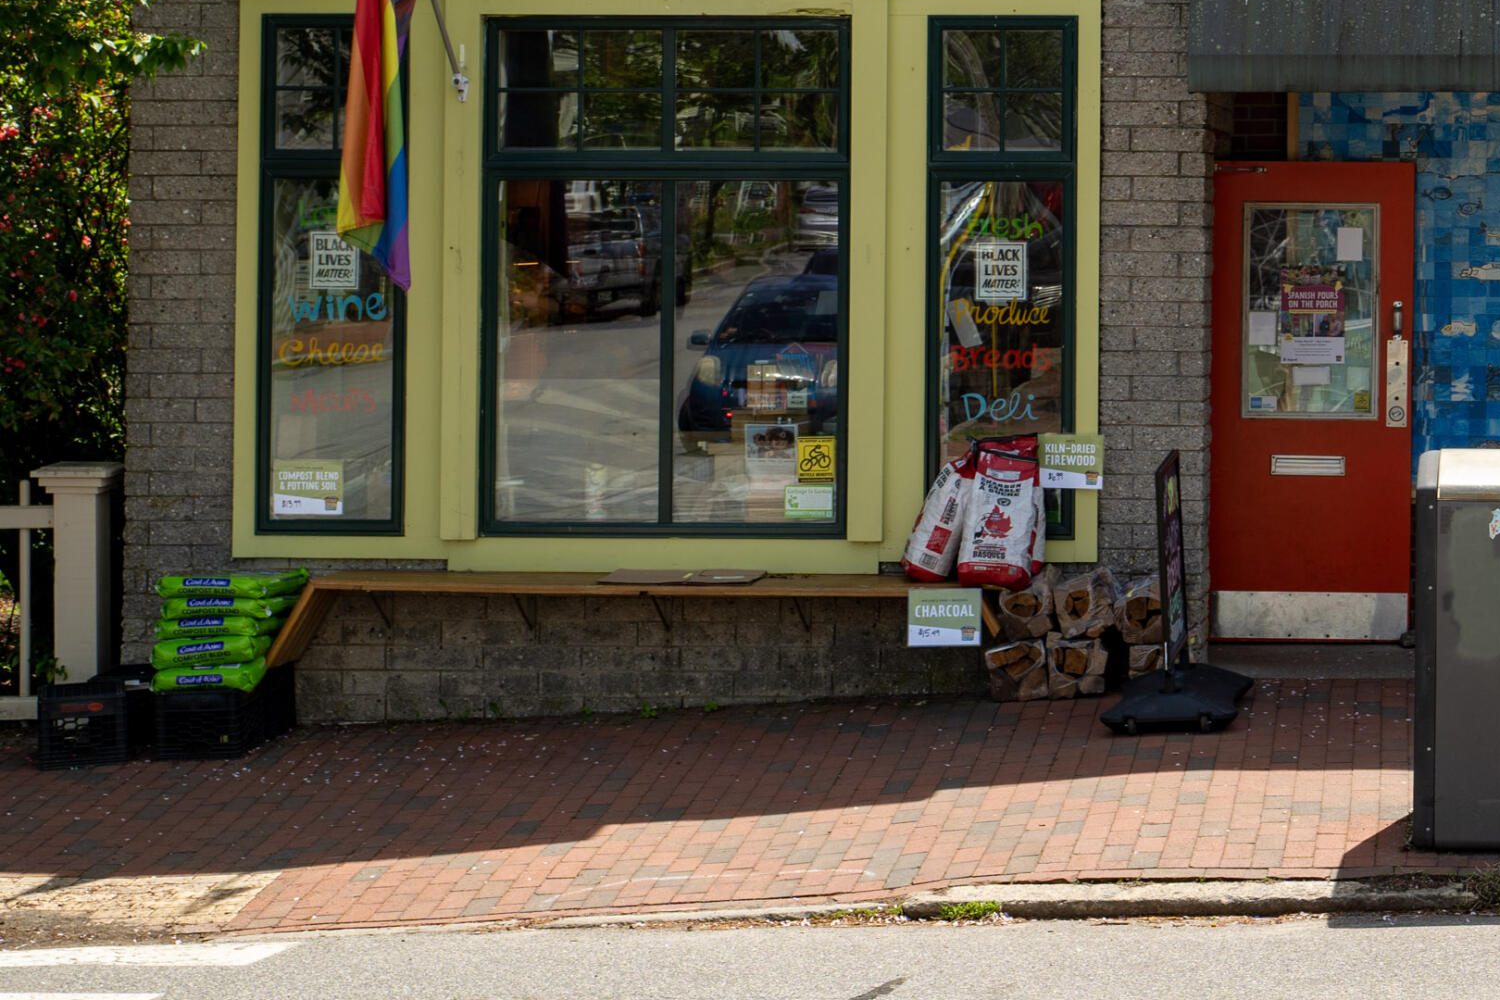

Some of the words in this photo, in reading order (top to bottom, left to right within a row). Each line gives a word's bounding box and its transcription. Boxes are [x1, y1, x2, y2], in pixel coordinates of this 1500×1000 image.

[967, 212, 1044, 239] Fresh
[316, 238, 354, 251] BLACK
[319, 254, 351, 265] LIVES
[982, 248, 1020, 261] BLACK
[984, 264, 1018, 275] LIVES
[1288, 291, 1315, 299] SPANISH
[1317, 291, 1338, 300] POURS
[1288, 300, 1299, 308] ON
[1301, 300, 1314, 308] THE
[1316, 300, 1338, 308] PORCH
[953, 296, 1051, 326] Produce
[278, 337, 386, 366] Cheese
[950, 343, 1052, 372] Breads
[961, 392, 1039, 422] Deli
[1045, 443, 1096, 454] KILN-DRIED
[1045, 454, 1096, 466] FIREWOOD
[278, 471, 313, 480] COMPOST
[316, 471, 339, 480] BLEND
[287, 481, 320, 490] POTTING
[322, 481, 337, 490] SOIL
[915, 604, 974, 618] CHARCOAL
